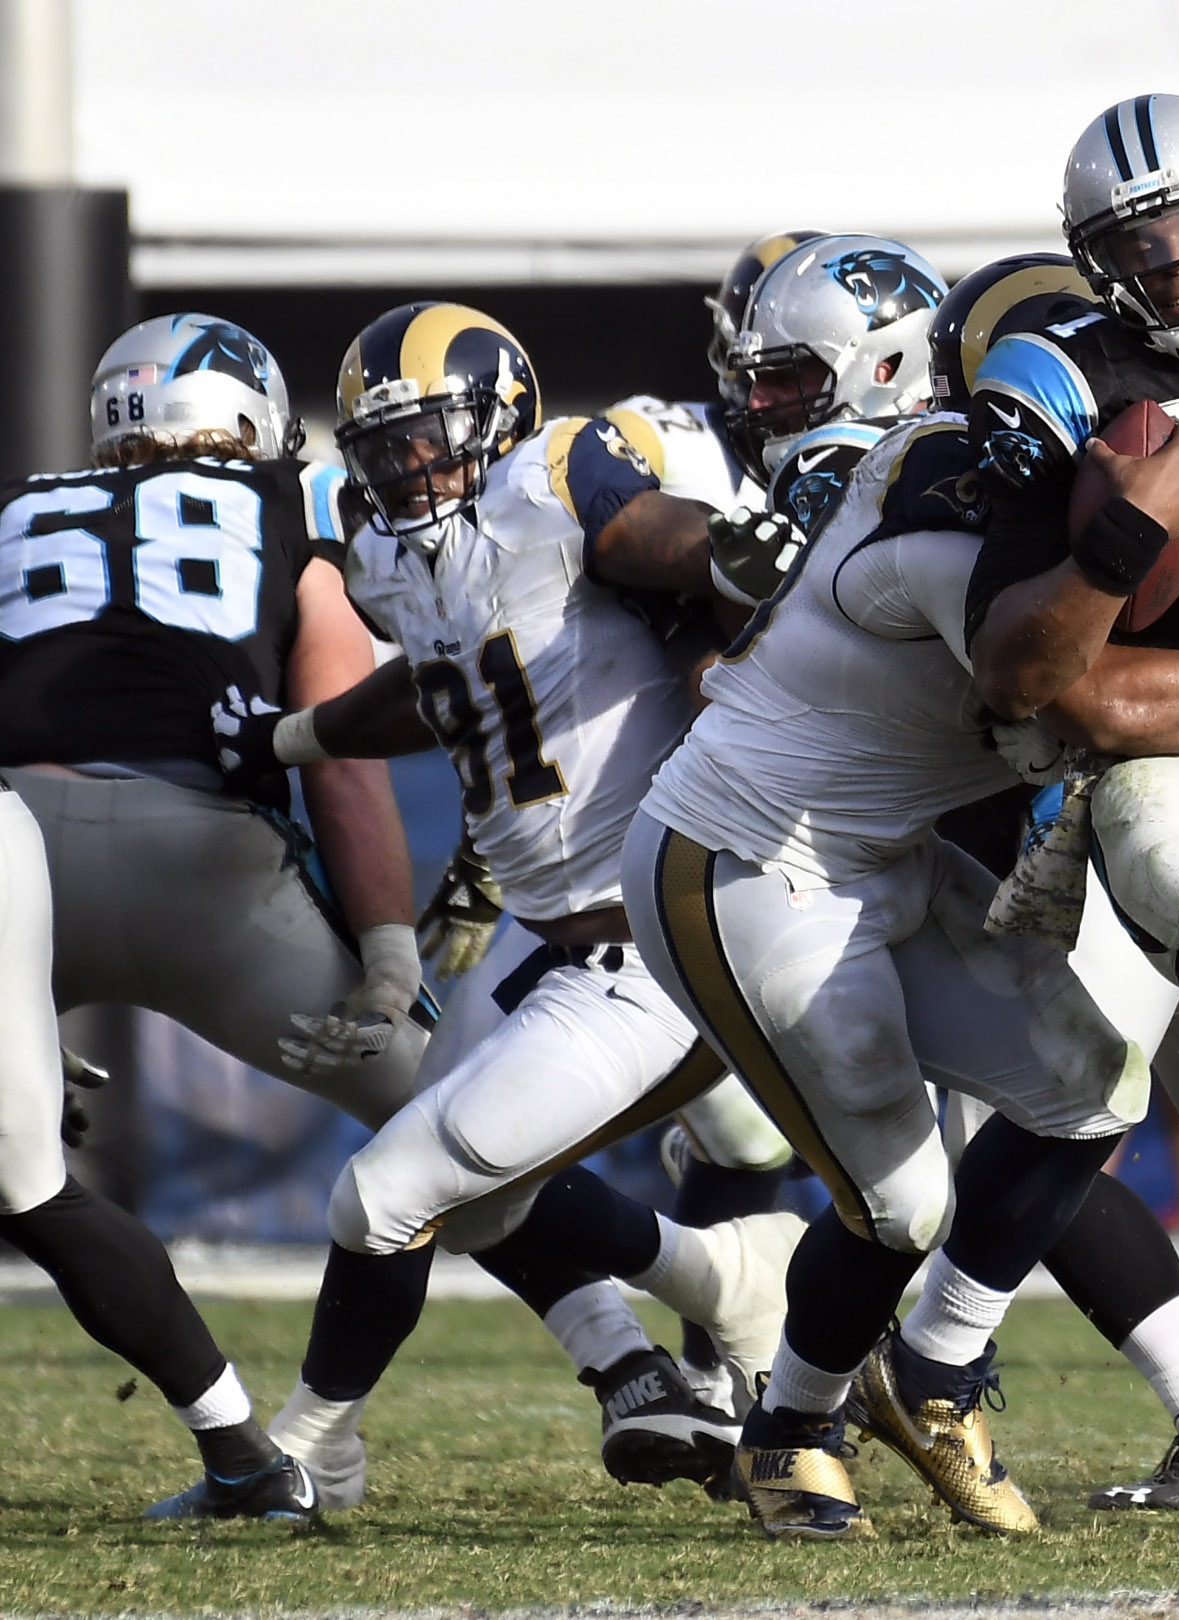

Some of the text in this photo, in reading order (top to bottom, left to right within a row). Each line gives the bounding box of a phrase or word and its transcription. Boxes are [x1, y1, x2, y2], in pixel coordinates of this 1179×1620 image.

[106, 391, 145, 427] 68
[0, 472, 262, 643] 68
[413, 627, 570, 819] 91
[606, 1370, 668, 1424] NIKE
[752, 1451, 801, 1482] NIKE
